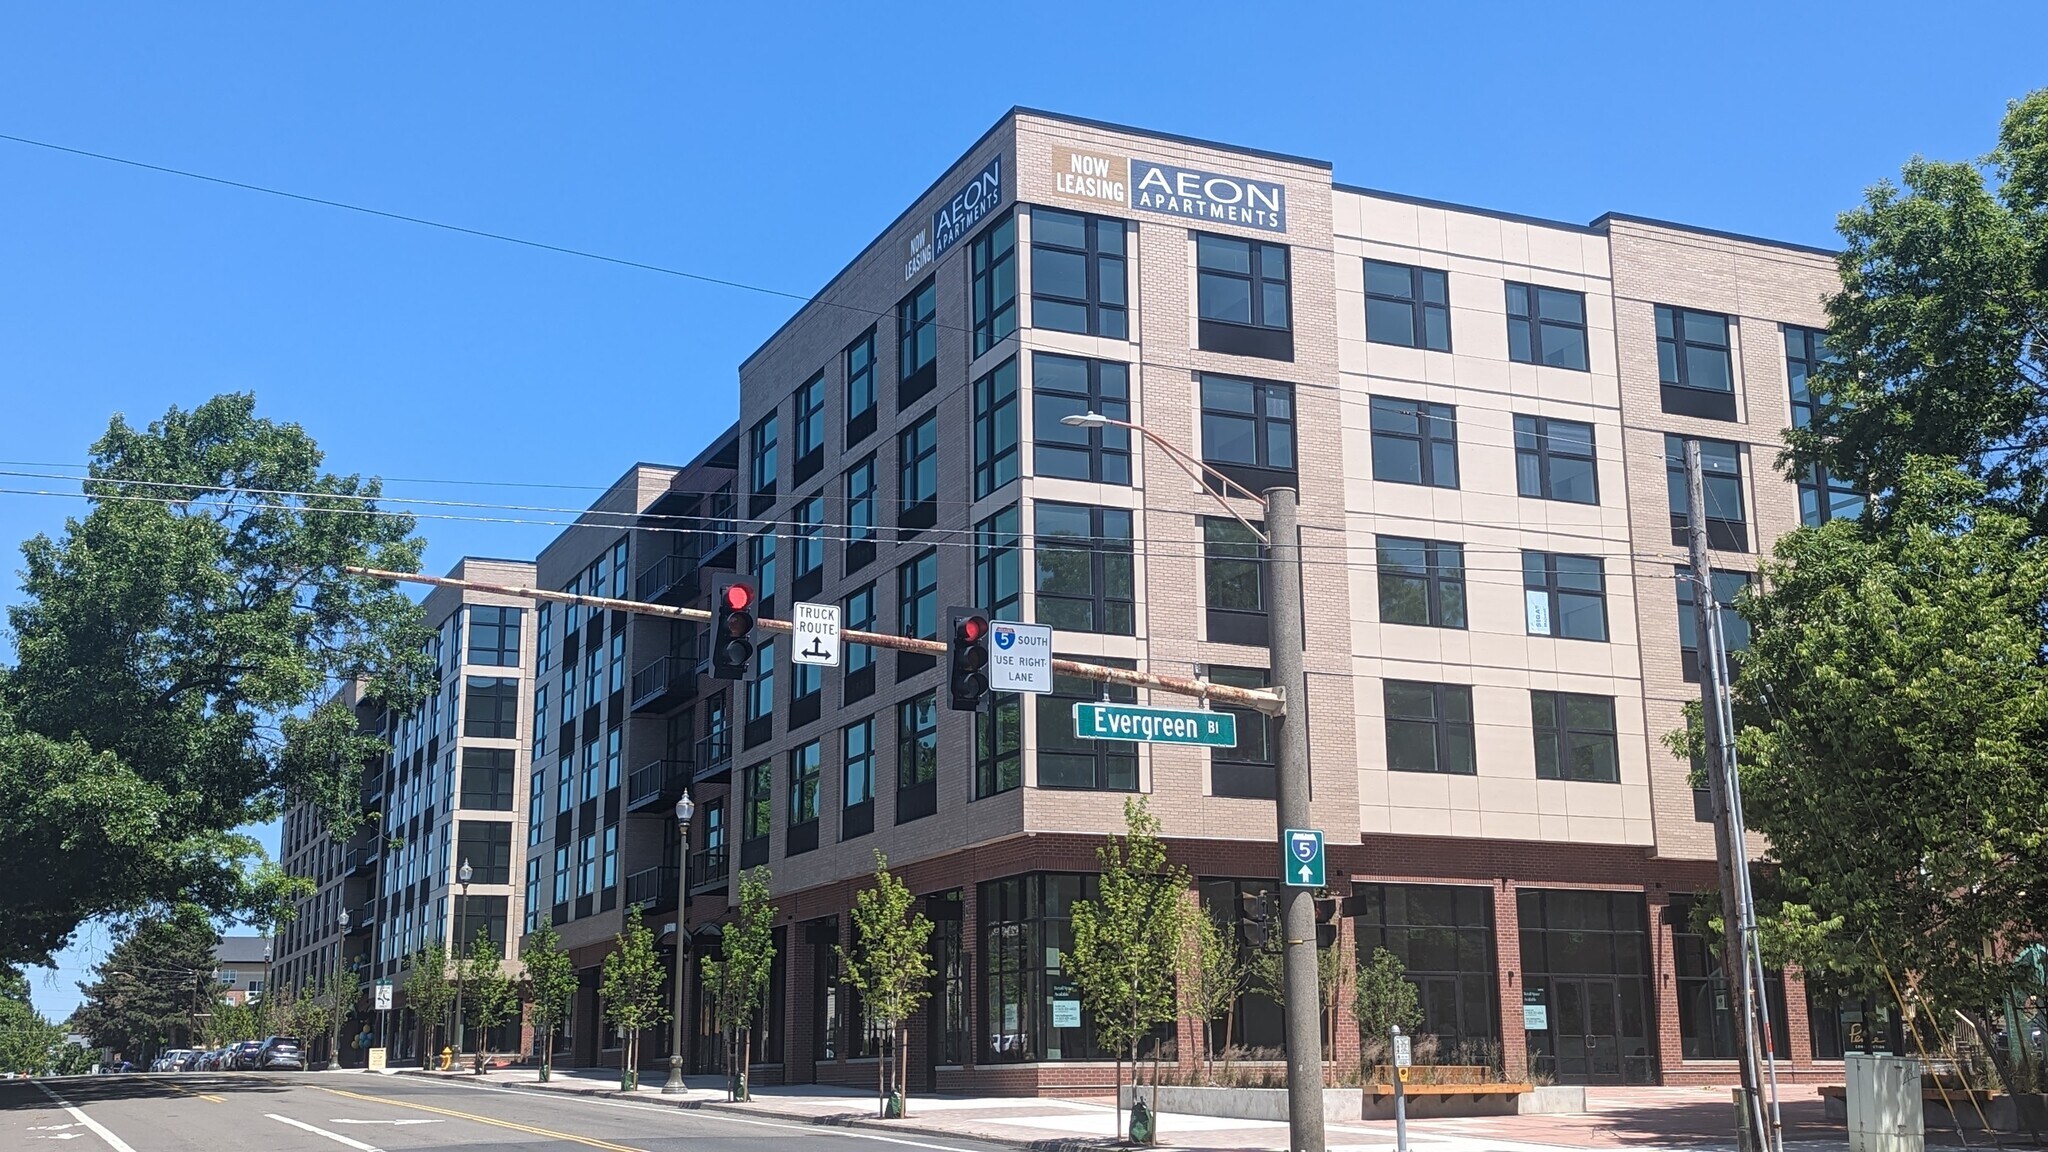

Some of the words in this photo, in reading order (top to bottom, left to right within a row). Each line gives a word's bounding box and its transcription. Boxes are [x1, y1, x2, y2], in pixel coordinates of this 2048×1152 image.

[1071, 153, 1110, 178] NOW
[936, 161, 999, 239] AEON
[1056, 172, 1124, 202] LEASING
[1138, 167, 1279, 212] AEON
[936, 188, 998, 254] APARTMENTS
[1139, 192, 1279, 228] APARTMENTS
[911, 228, 926, 257] NOW
[905, 243, 932, 281] LEASING
[799, 606, 835, 621] TRUCK
[799, 621, 835, 636] ROUTE
[1000, 633, 1010, 646] 5
[1017, 635, 1048, 647] SOUTH
[995, 655, 1014, 666] USE
[1019, 656, 1046, 668] RIGHT
[1008, 671, 1034, 683] LANE
[1094, 706, 1198, 741] Evergreen
[1299, 842, 1311, 858] 5
